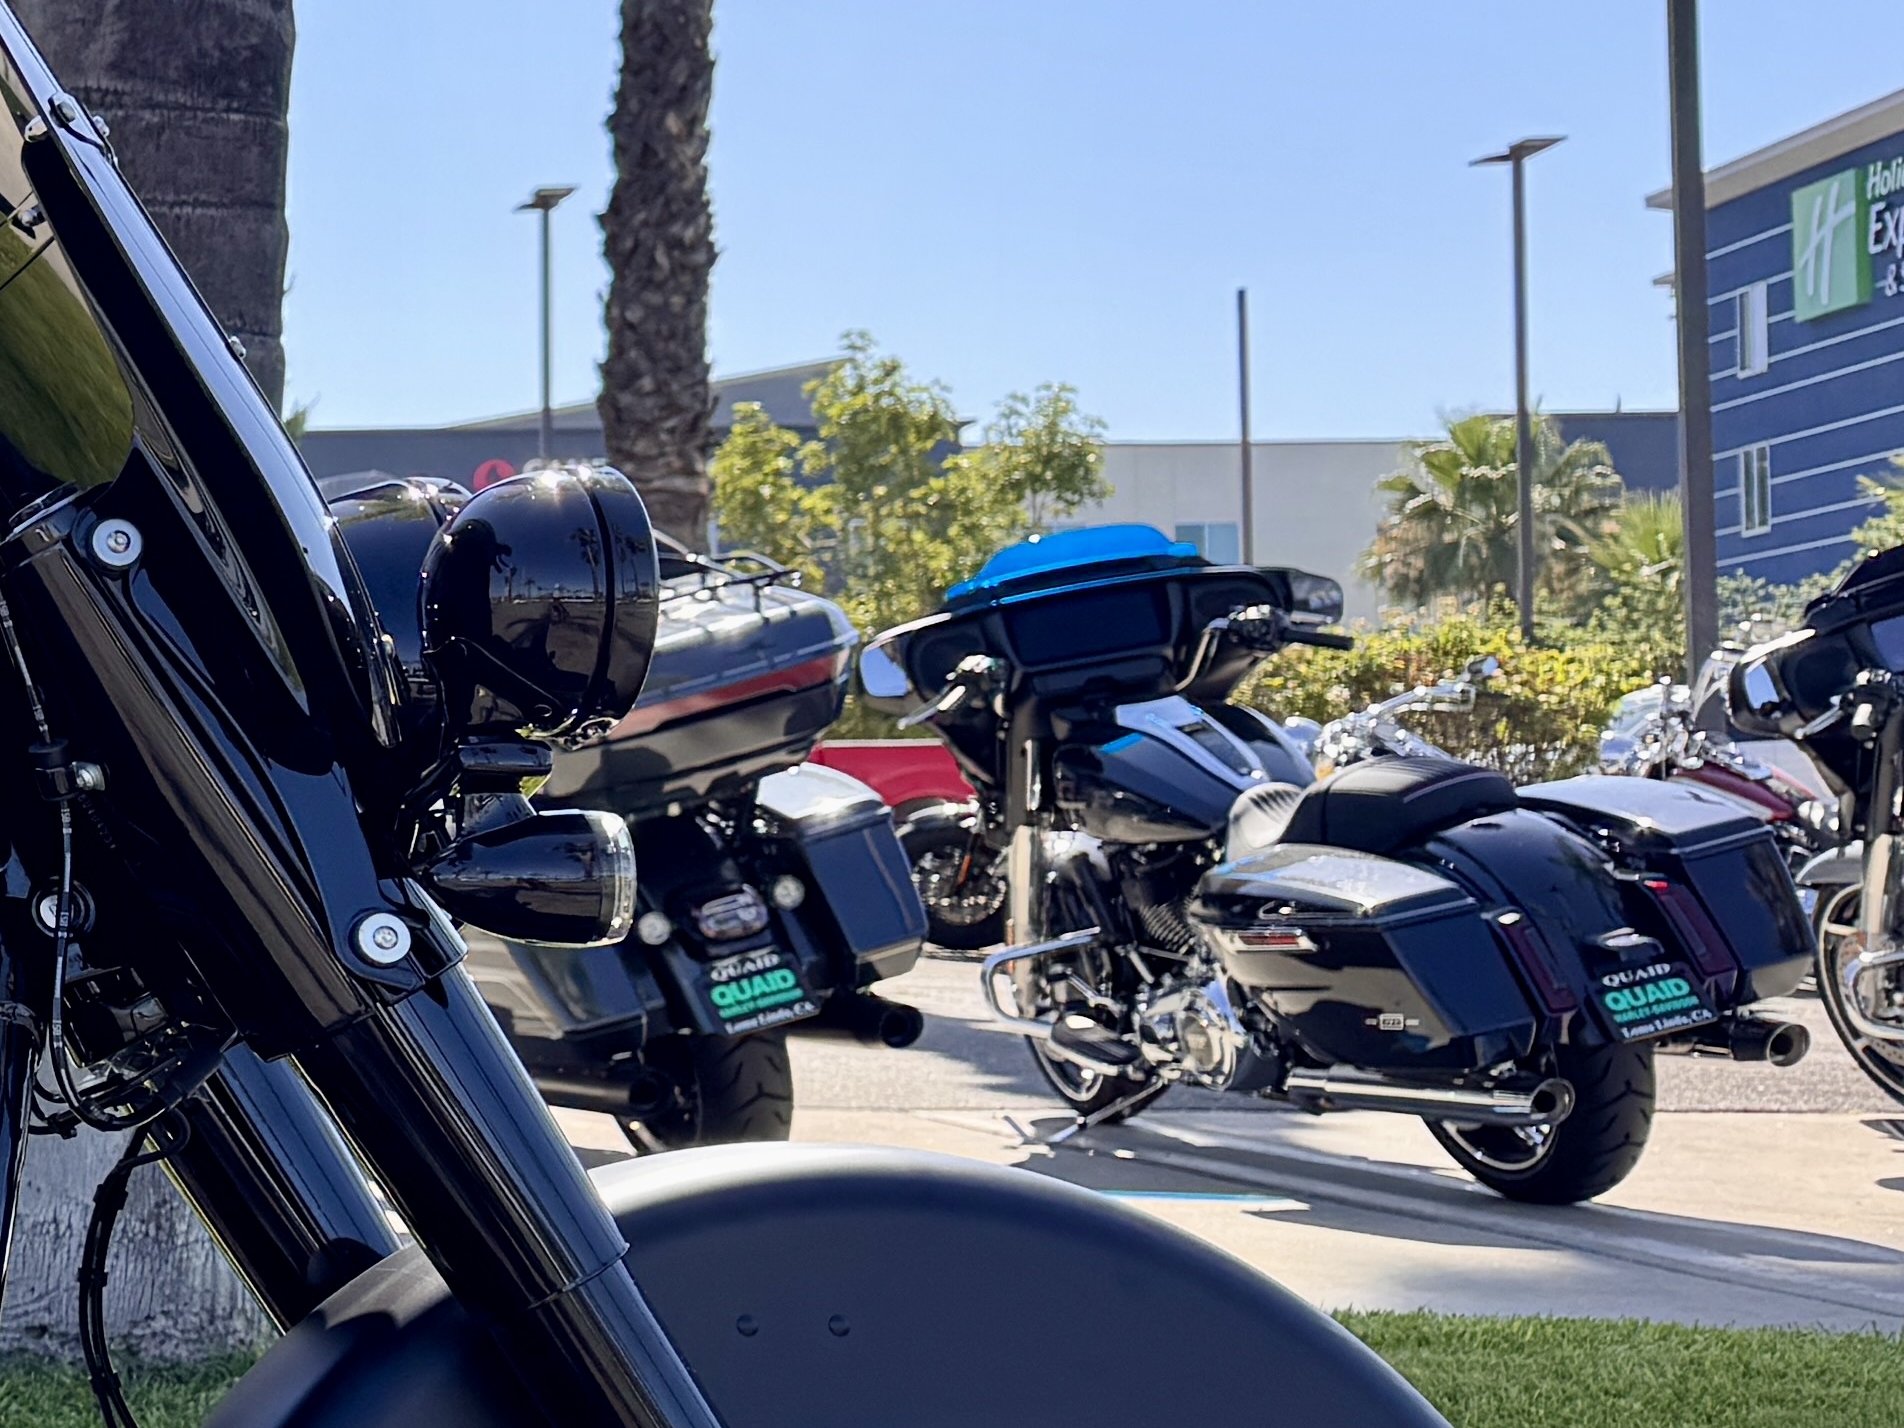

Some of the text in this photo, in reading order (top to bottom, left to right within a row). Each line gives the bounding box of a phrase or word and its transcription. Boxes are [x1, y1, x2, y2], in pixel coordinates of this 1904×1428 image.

[710, 953, 781, 982] QUAID
[1602, 962, 1671, 988] QUAID
[711, 968, 796, 1007] QUAID
[1605, 977, 1691, 1012] QUAID
